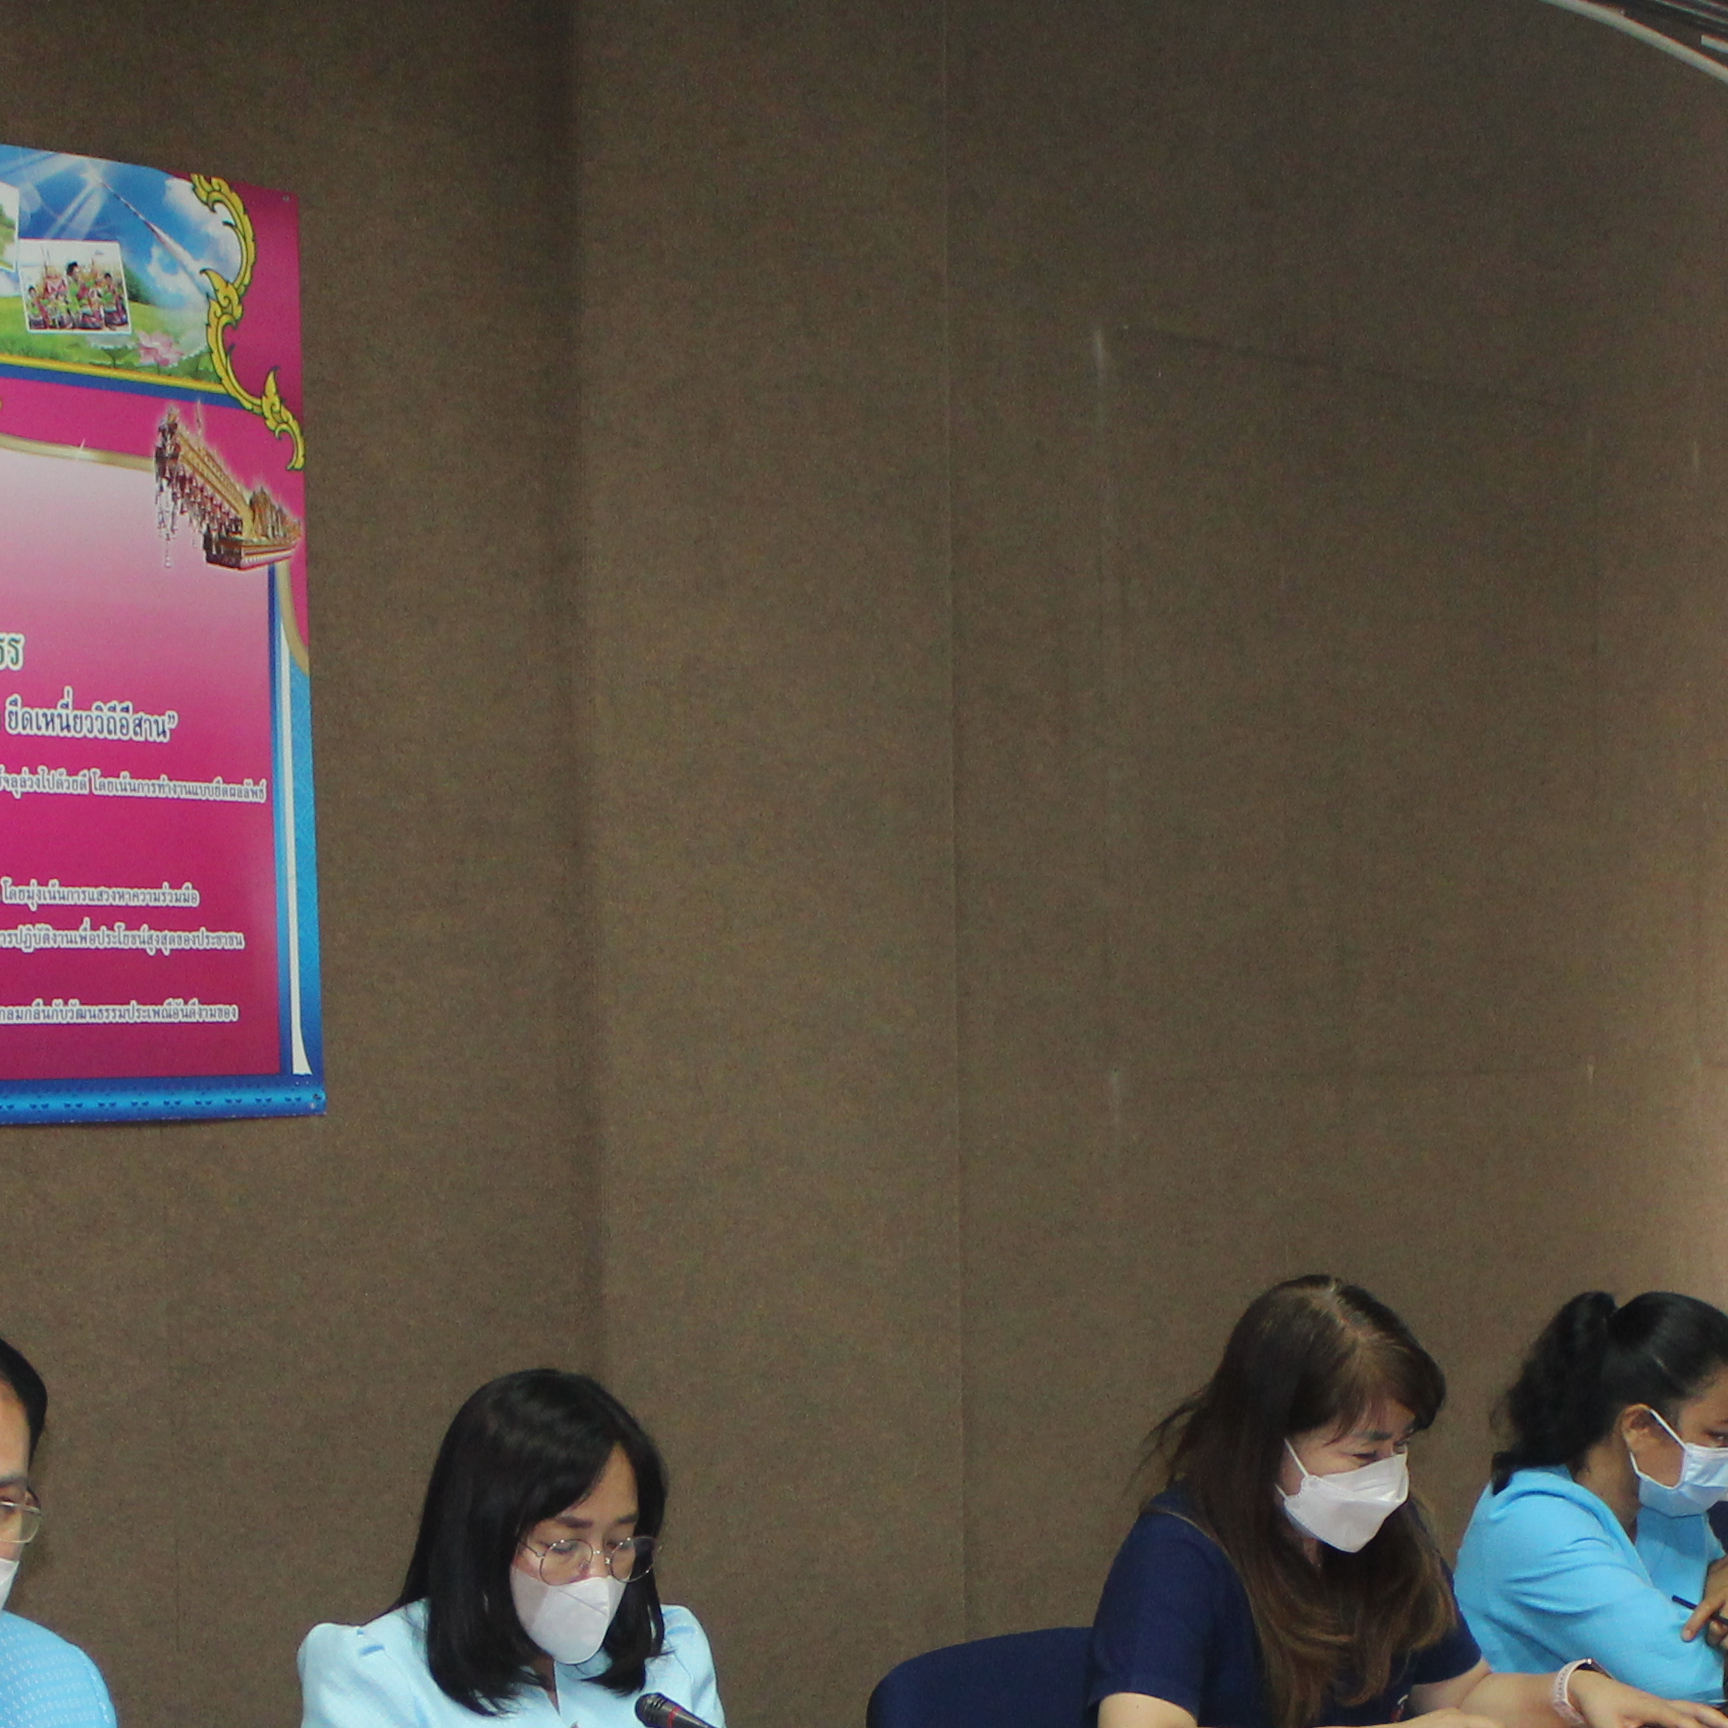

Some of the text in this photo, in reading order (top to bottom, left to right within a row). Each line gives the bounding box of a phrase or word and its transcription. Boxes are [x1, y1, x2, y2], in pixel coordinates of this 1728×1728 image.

[6, 688, 177, 741] ยึดเหนี่ยววิถีอีสาน”
